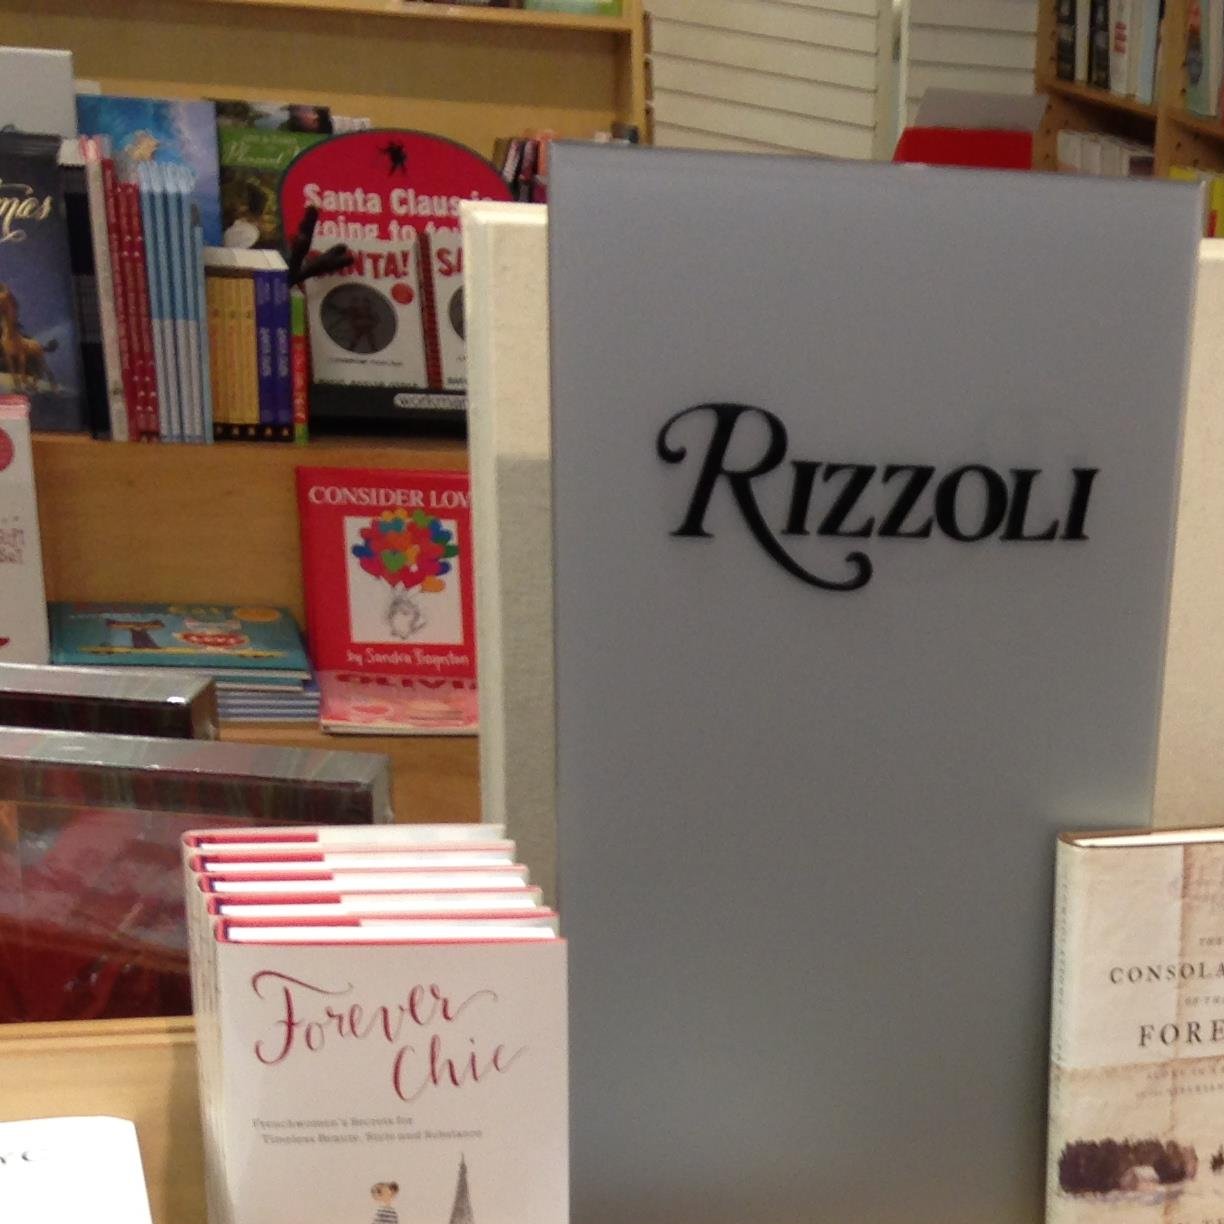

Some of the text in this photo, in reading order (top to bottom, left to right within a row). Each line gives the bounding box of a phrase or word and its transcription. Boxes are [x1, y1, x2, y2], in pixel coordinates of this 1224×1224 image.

[303, 183, 382, 214] Santa
[308, 486, 471, 508] CONSIDER LOV
[252, 969, 498, 1066] Forever
[393, 1033, 527, 1102] Chic
